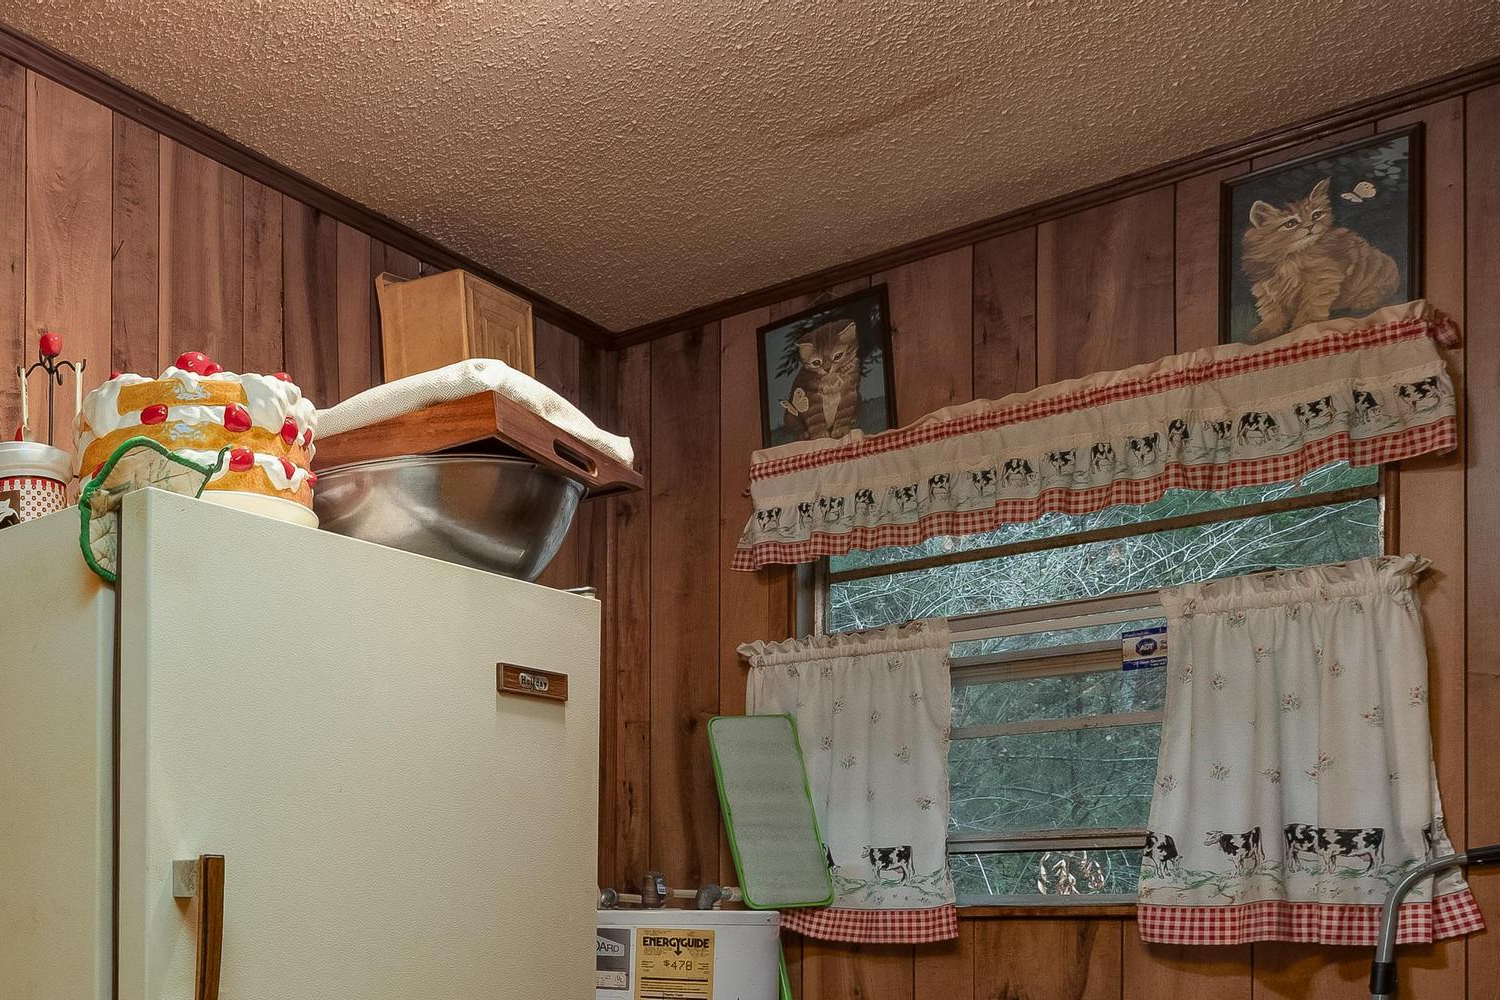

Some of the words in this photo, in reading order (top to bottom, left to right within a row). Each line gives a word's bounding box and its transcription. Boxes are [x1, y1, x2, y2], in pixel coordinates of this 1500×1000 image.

[1140, 643, 1155, 652] ADT
[642, 936, 710, 949] ENERGYGUIDE
[662, 959, 693, 971] $478
